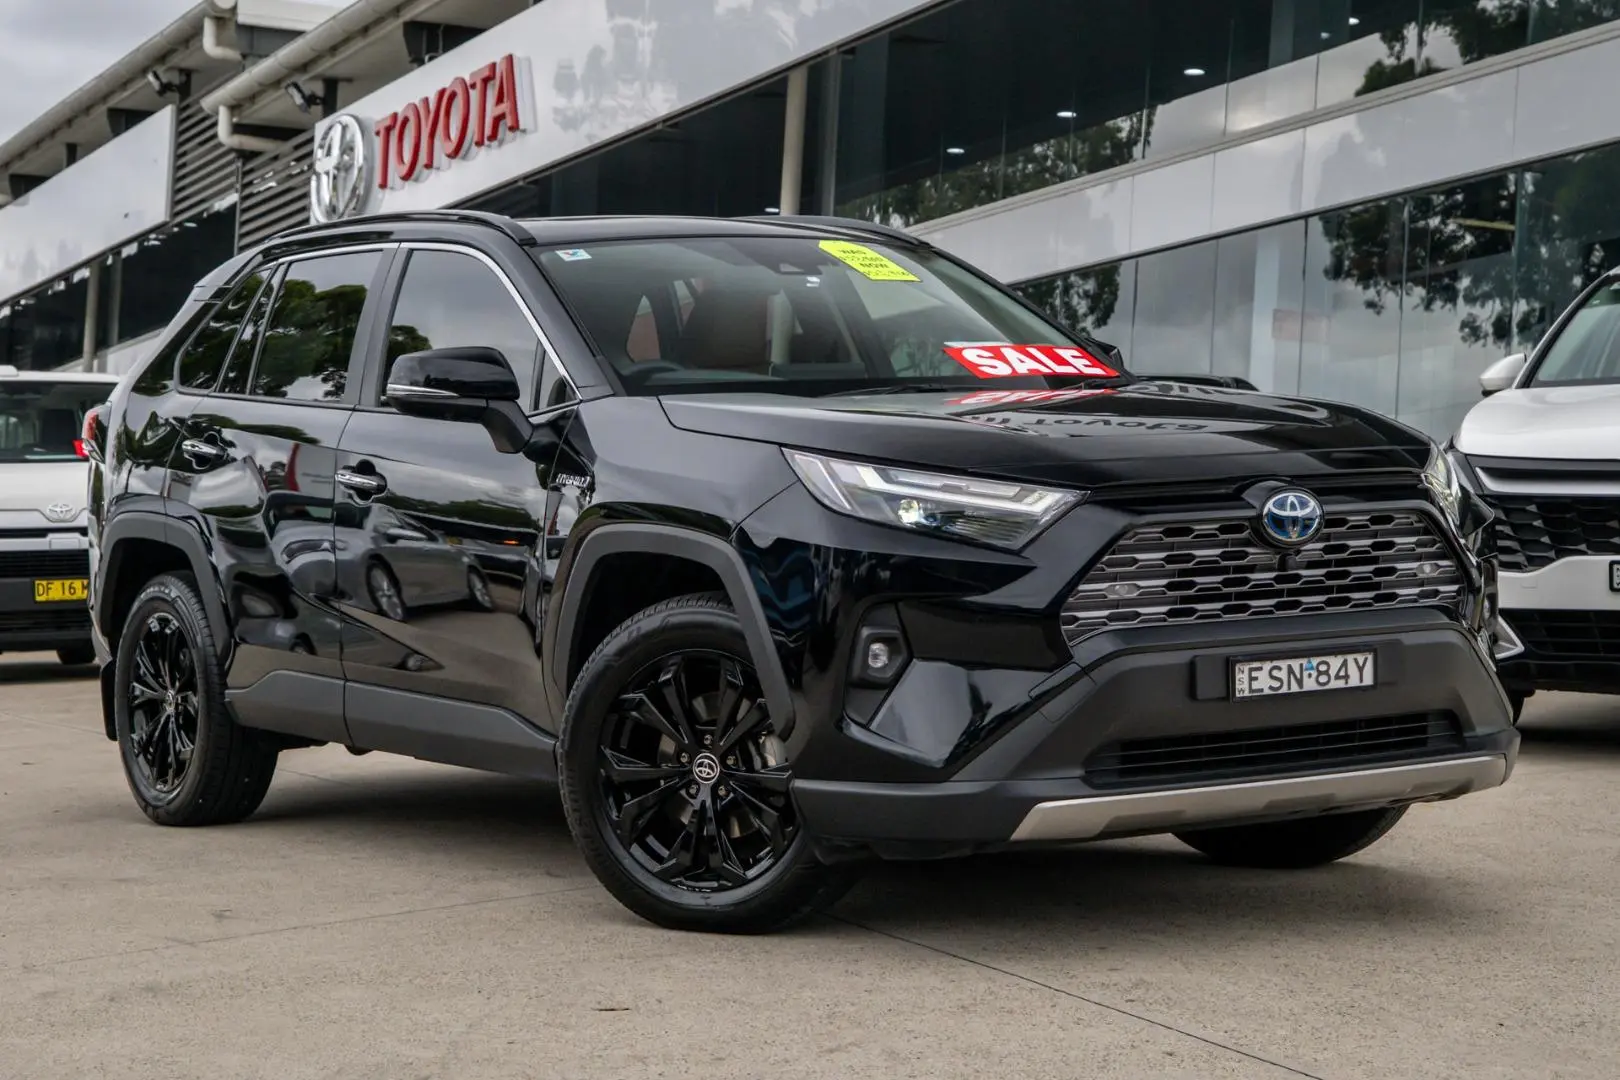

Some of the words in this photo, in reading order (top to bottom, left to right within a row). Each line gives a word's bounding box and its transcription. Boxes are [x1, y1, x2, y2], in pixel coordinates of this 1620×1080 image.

[375, 53, 520, 190] TOYOTA
[961, 347, 1108, 376] SALE
[37, 582, 54, 597] DF
[62, 582, 76, 596] 16
